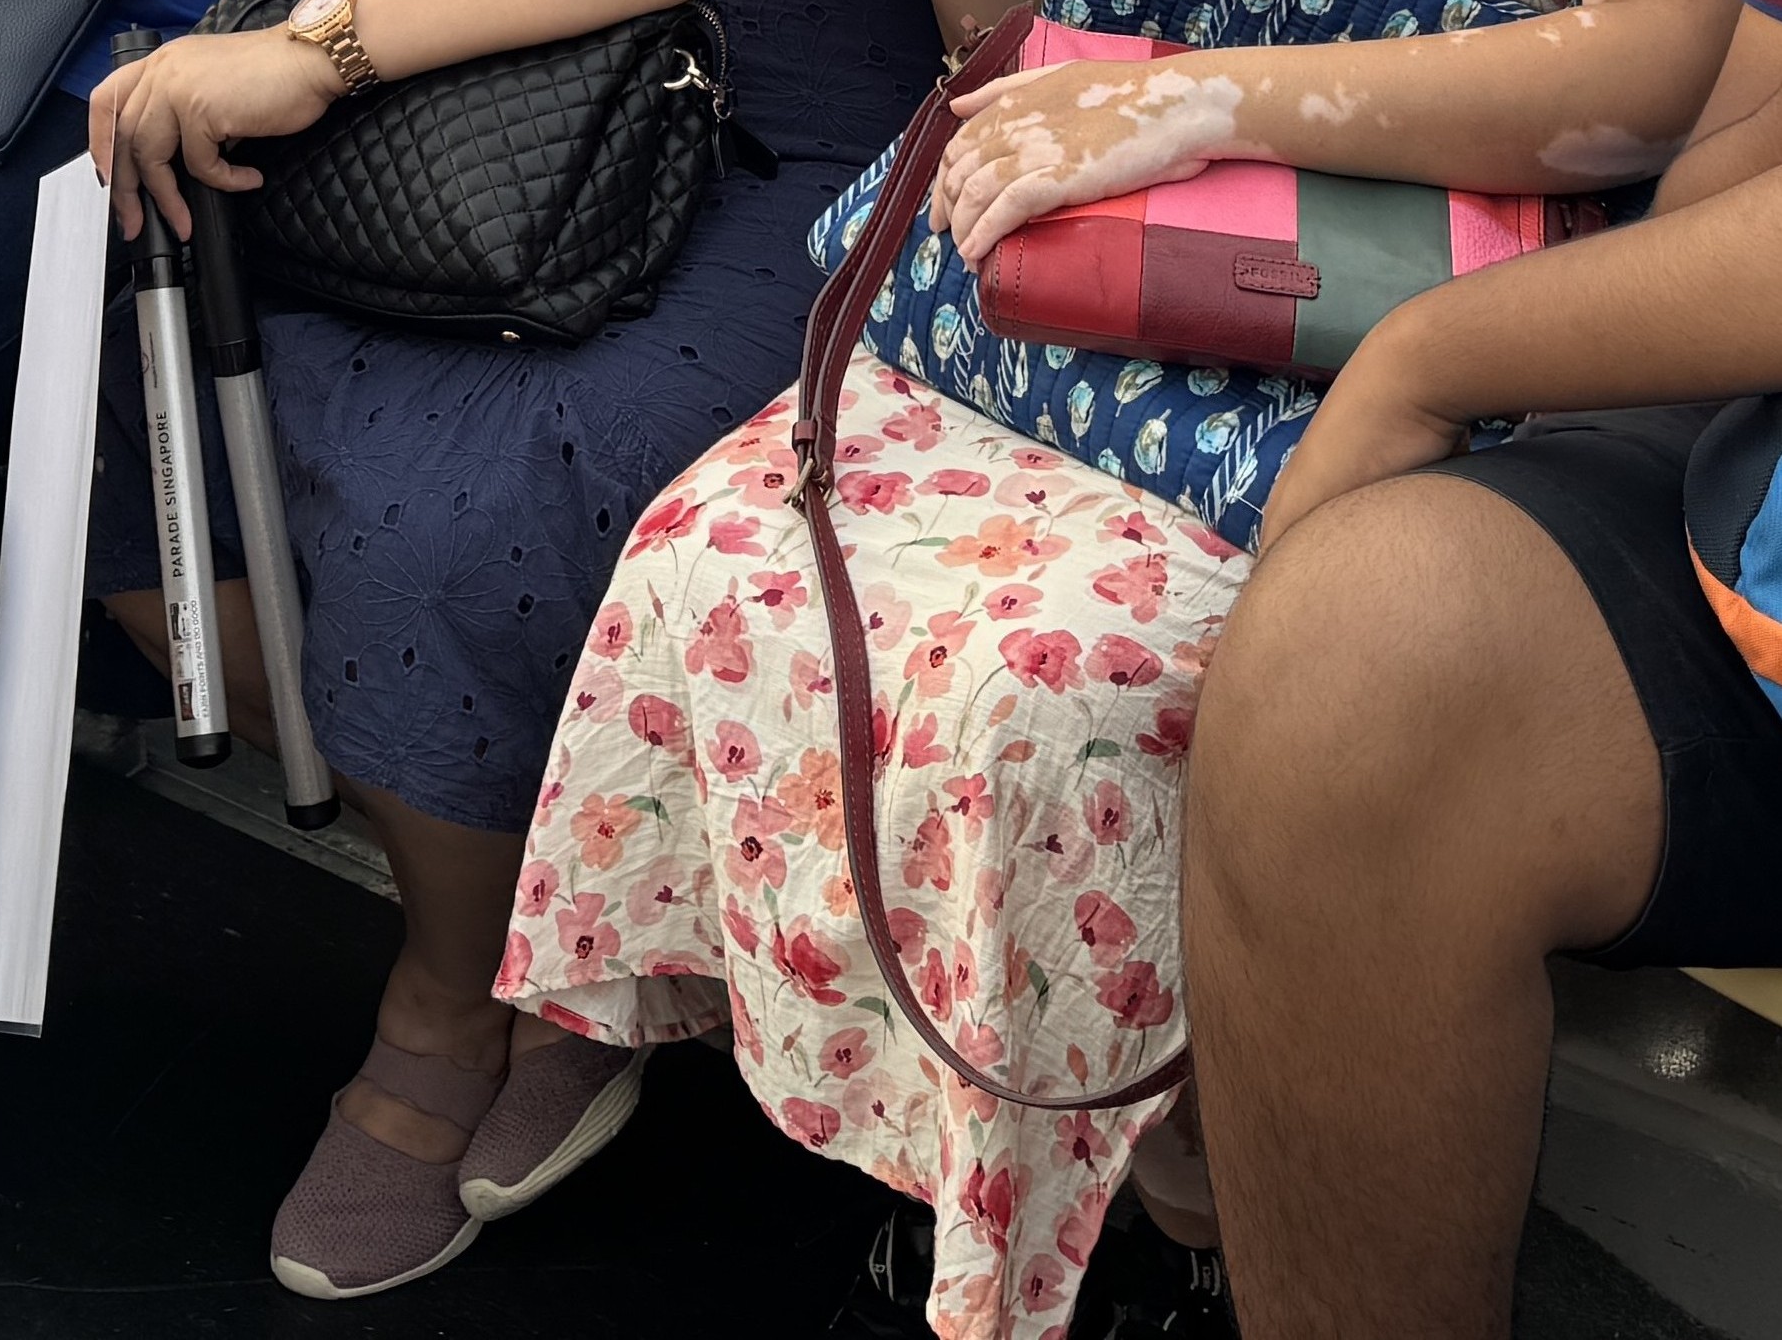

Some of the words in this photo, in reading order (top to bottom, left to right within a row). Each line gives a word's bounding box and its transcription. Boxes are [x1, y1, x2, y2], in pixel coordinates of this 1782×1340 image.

[1250, 266, 1304, 283] FOSSIL
[156, 411, 178, 506] SINGAPORE
[166, 512, 185, 578] PARADE
